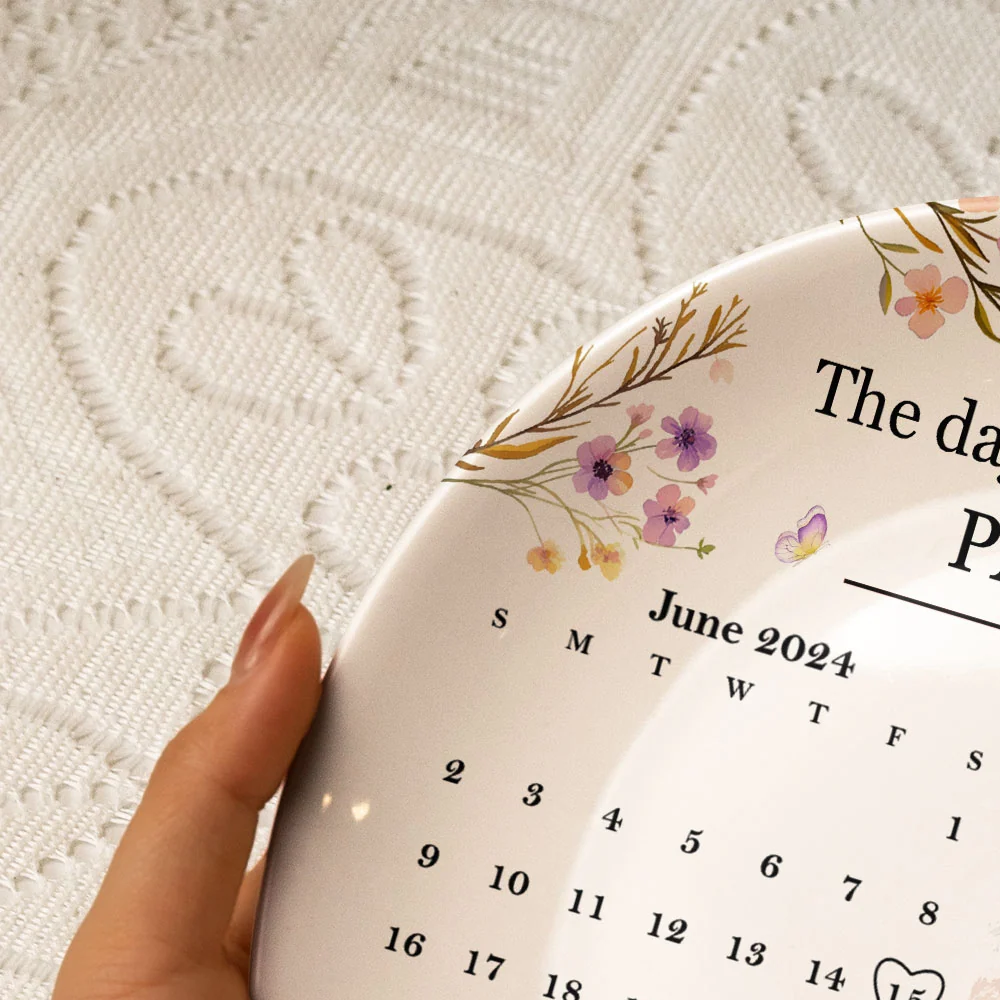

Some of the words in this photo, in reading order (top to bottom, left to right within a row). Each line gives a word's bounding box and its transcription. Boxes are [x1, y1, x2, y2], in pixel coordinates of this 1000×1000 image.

[814, 357, 921, 440] The
[648, 587, 744, 645] June
[753, 626, 856, 679] 2024
[491, 607, 509, 629] S
[565, 628, 595, 656] M
[650, 653, 672, 677] T
[726, 675, 755, 702] W
[808, 700, 830, 725] T
[885, 724, 907, 747] F
[966, 749, 984, 772] S
[442, 759, 466, 785] 2
[521, 782, 545, 807] 3
[601, 807, 624, 833] 4
[679, 829, 704, 855] 5
[760, 853, 783, 879] 6
[842, 874, 863, 902] 7
[918, 900, 940, 926] 8
[945, 816, 962, 842] 1
[384, 926, 427, 958] 16
[463, 950, 506, 981] 17
[417, 843, 440, 869] 9
[488, 864, 530, 896] 10
[567, 888, 605, 921] 11
[646, 912, 688, 945] 12
[726, 935, 767, 967] 13
[805, 959, 846, 993] 14
